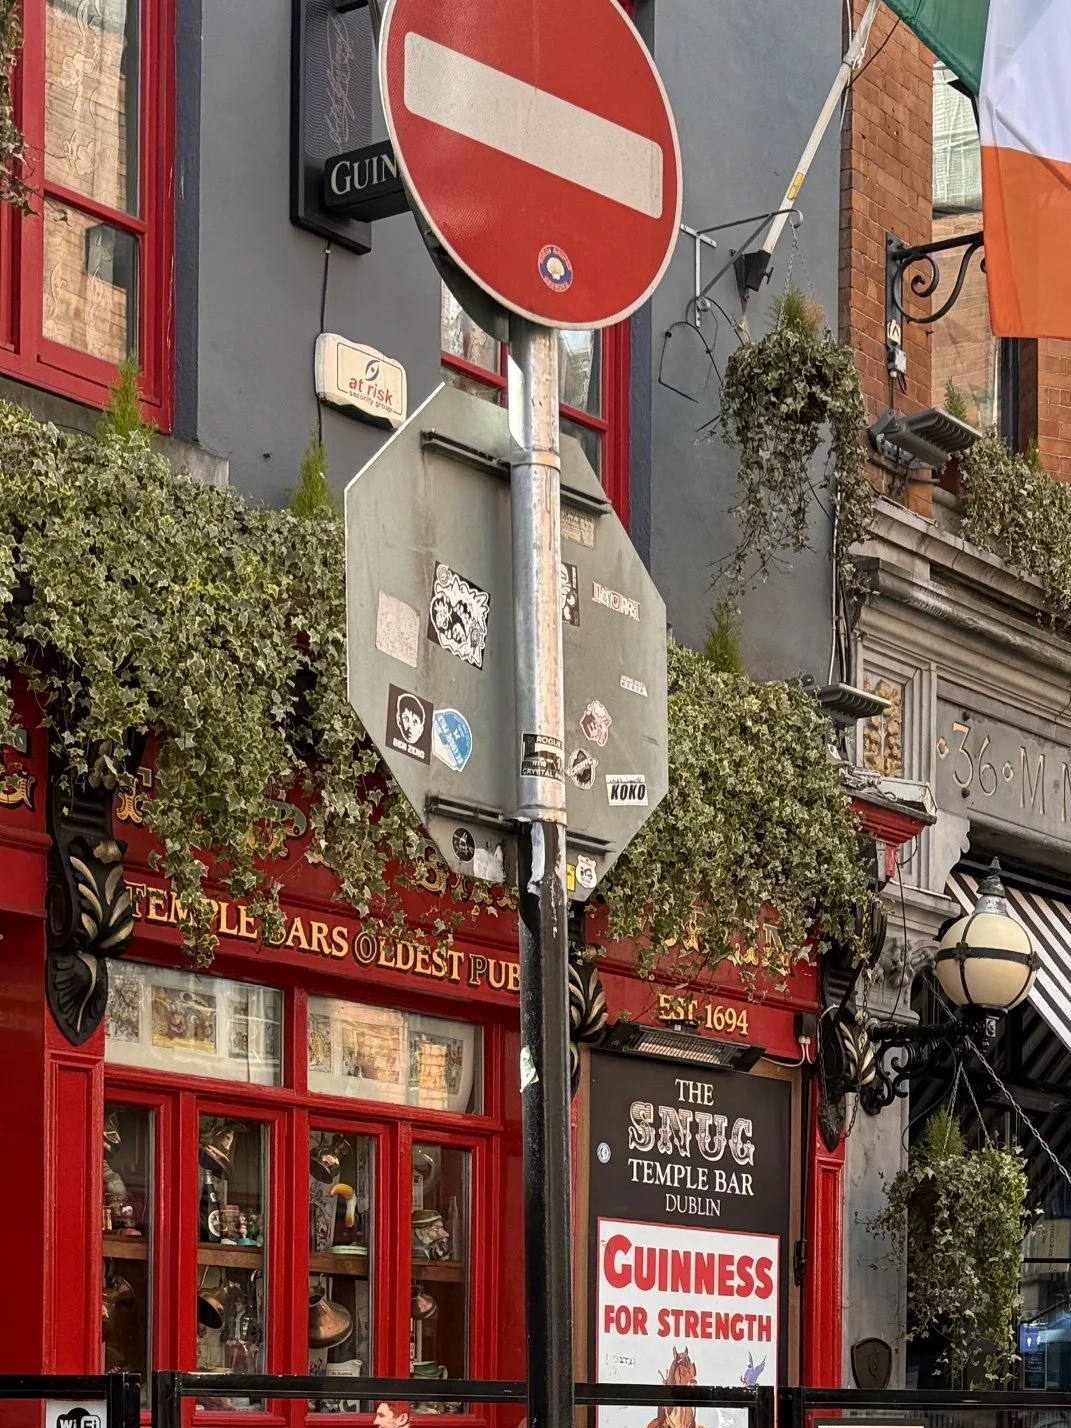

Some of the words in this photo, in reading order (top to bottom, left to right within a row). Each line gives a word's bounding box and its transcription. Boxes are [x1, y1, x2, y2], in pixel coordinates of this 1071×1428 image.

[330, 153, 398, 195] GUIN
[349, 377, 363, 392] at
[367, 384, 392, 405] risk
[349, 391, 374, 405] security
[375, 401, 392, 412] group
[951, 722, 998, 797] 36
[1019, 746, 1046, 815] M
[610, 784, 646, 801] KOKO
[269, 909, 349, 957] ARS
[355, 931, 465, 980] OLDEST
[703, 1003, 749, 1036] 1694
[675, 1079, 715, 1106] THE
[628, 1101, 755, 1167] SNUG
[628, 1158, 709, 1192] TEMPLE
[714, 1169, 755, 1196] BAR
[665, 1193, 721, 1217] DUBLIN
[603, 1234, 774, 1300] GUINNESS
[604, 1304, 649, 1336] FOR
[657, 1307, 772, 1342] STRENGTH
